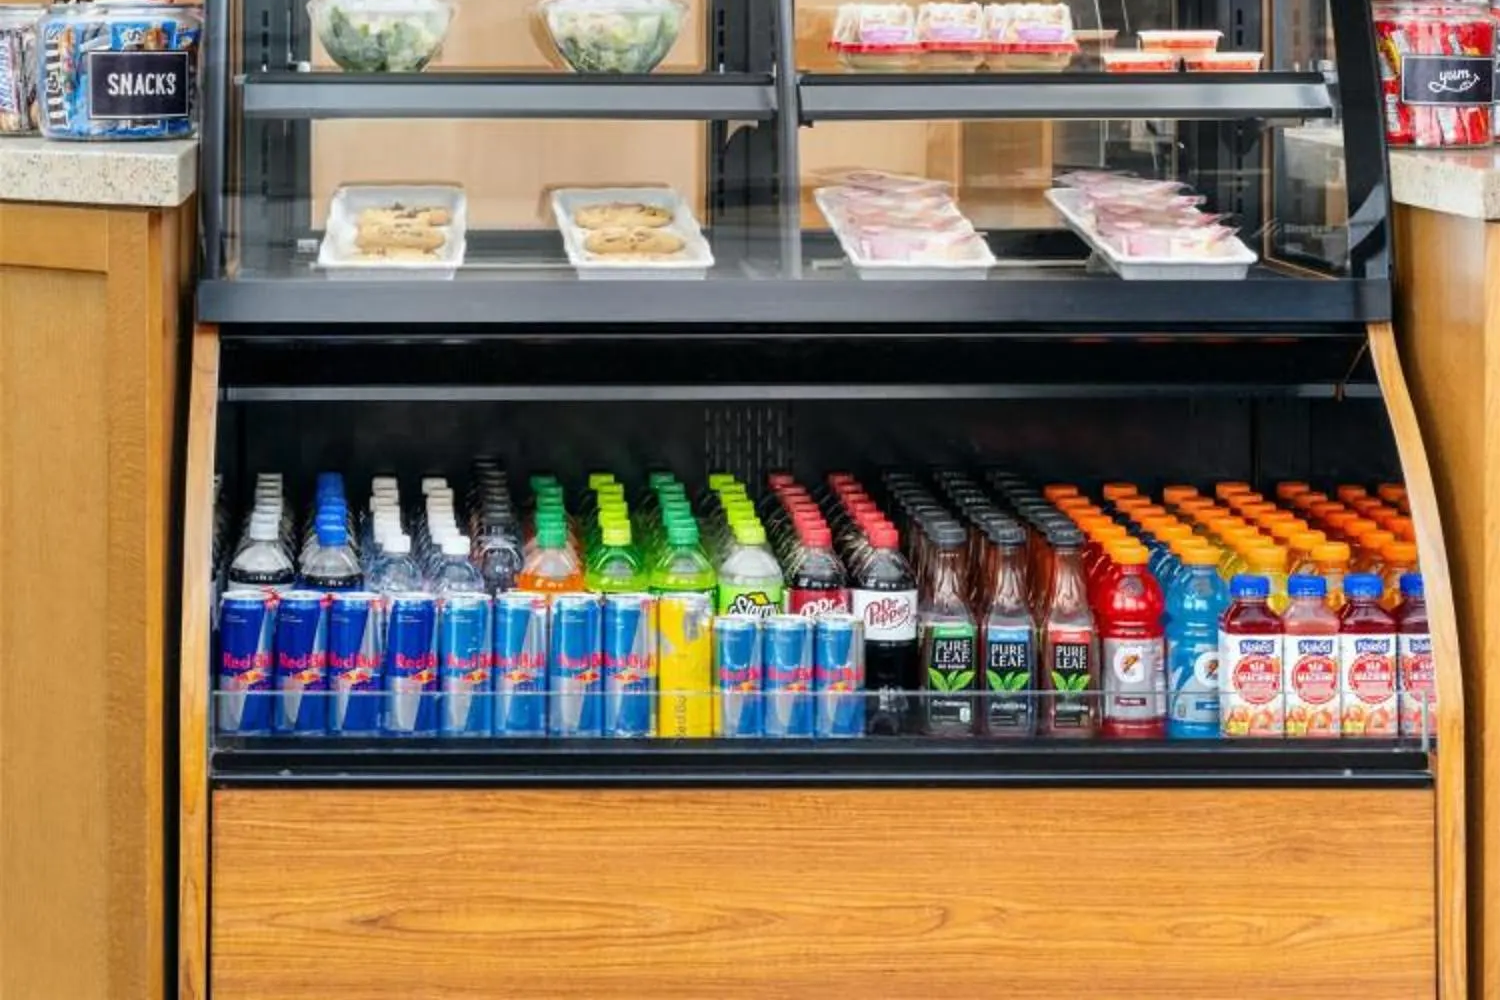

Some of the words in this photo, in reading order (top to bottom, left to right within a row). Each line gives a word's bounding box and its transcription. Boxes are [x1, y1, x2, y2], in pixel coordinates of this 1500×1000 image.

[107, 71, 178, 96] SNACKS
[935, 639, 970, 651] PURE
[991, 643, 1025, 655] PURE
[1055, 645, 1086, 657] PURE
[223, 652, 251, 668] Red
[395, 652, 426, 668] Red
